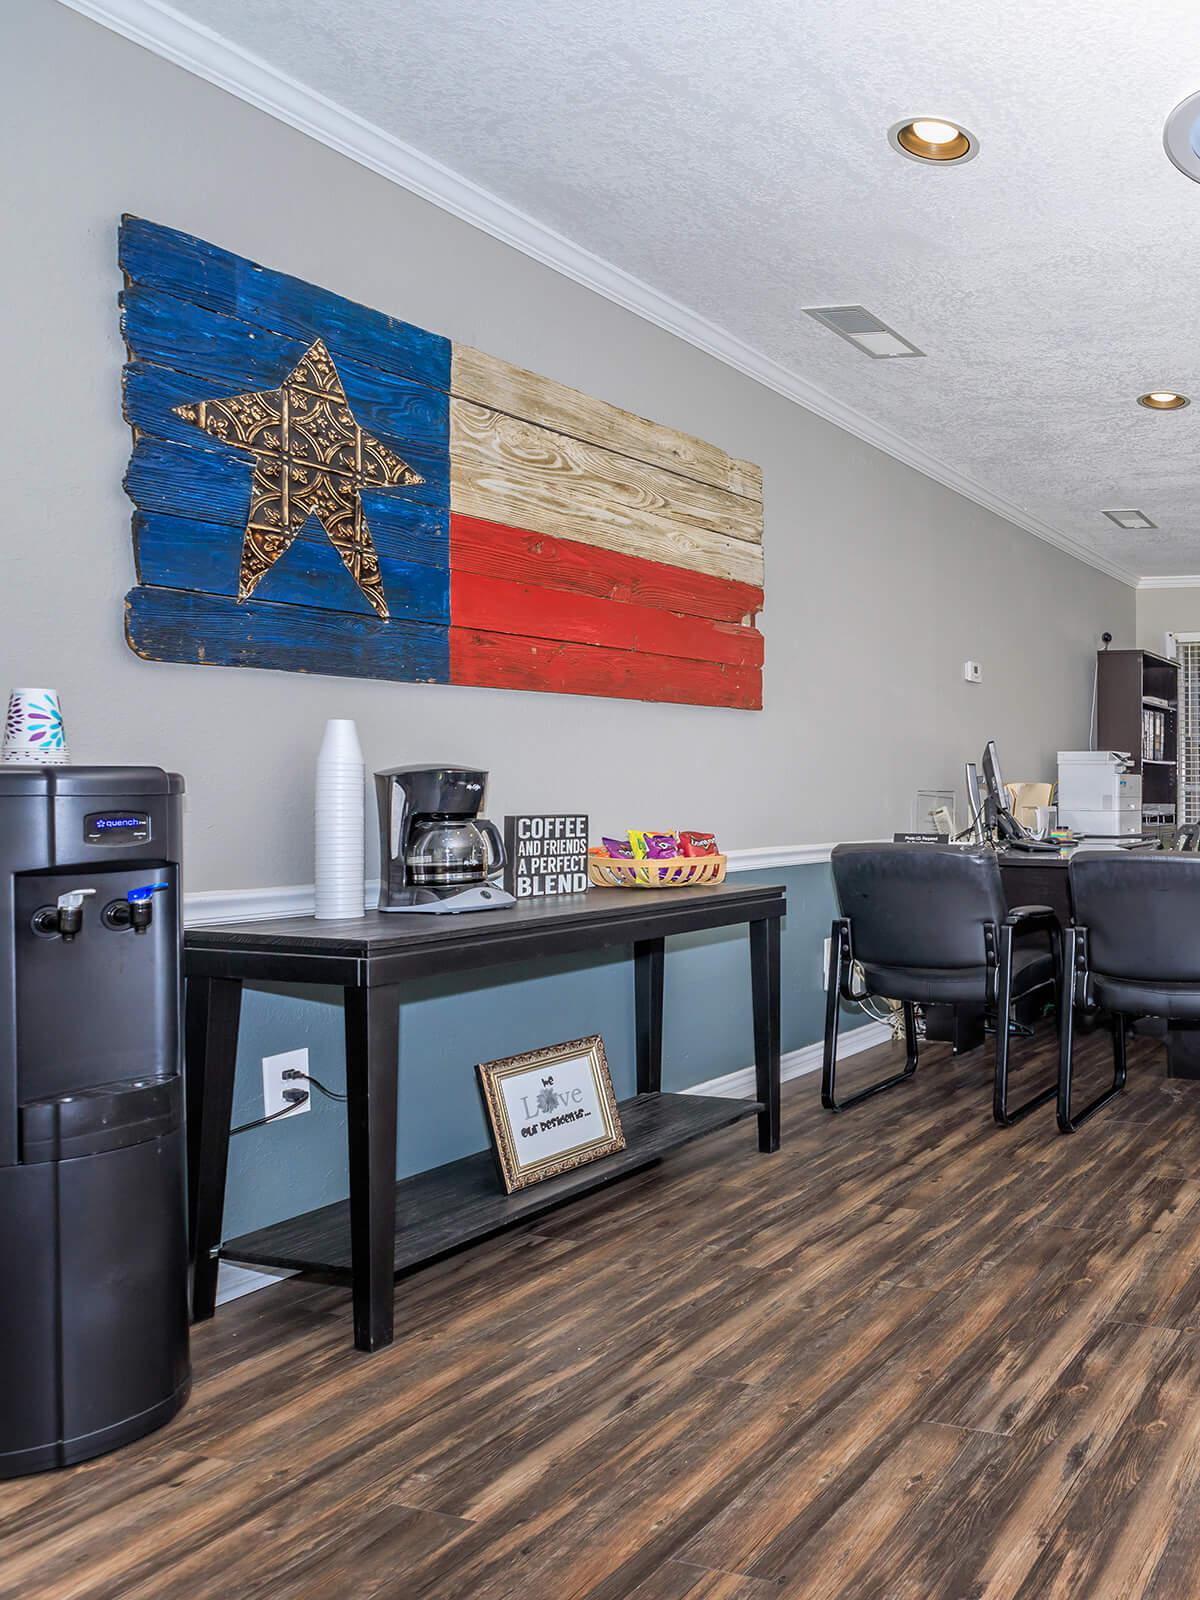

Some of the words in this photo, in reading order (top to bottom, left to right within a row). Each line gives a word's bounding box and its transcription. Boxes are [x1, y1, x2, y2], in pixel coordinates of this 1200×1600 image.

[105, 818, 139, 828] quench
[518, 817, 586, 839] COFFEE
[518, 840, 541, 857] AND
[543, 838, 587, 856] FRIENDS
[518, 858, 528, 875] A
[531, 855, 587, 874] PERFECT
[517, 873, 587, 897] BLEND
